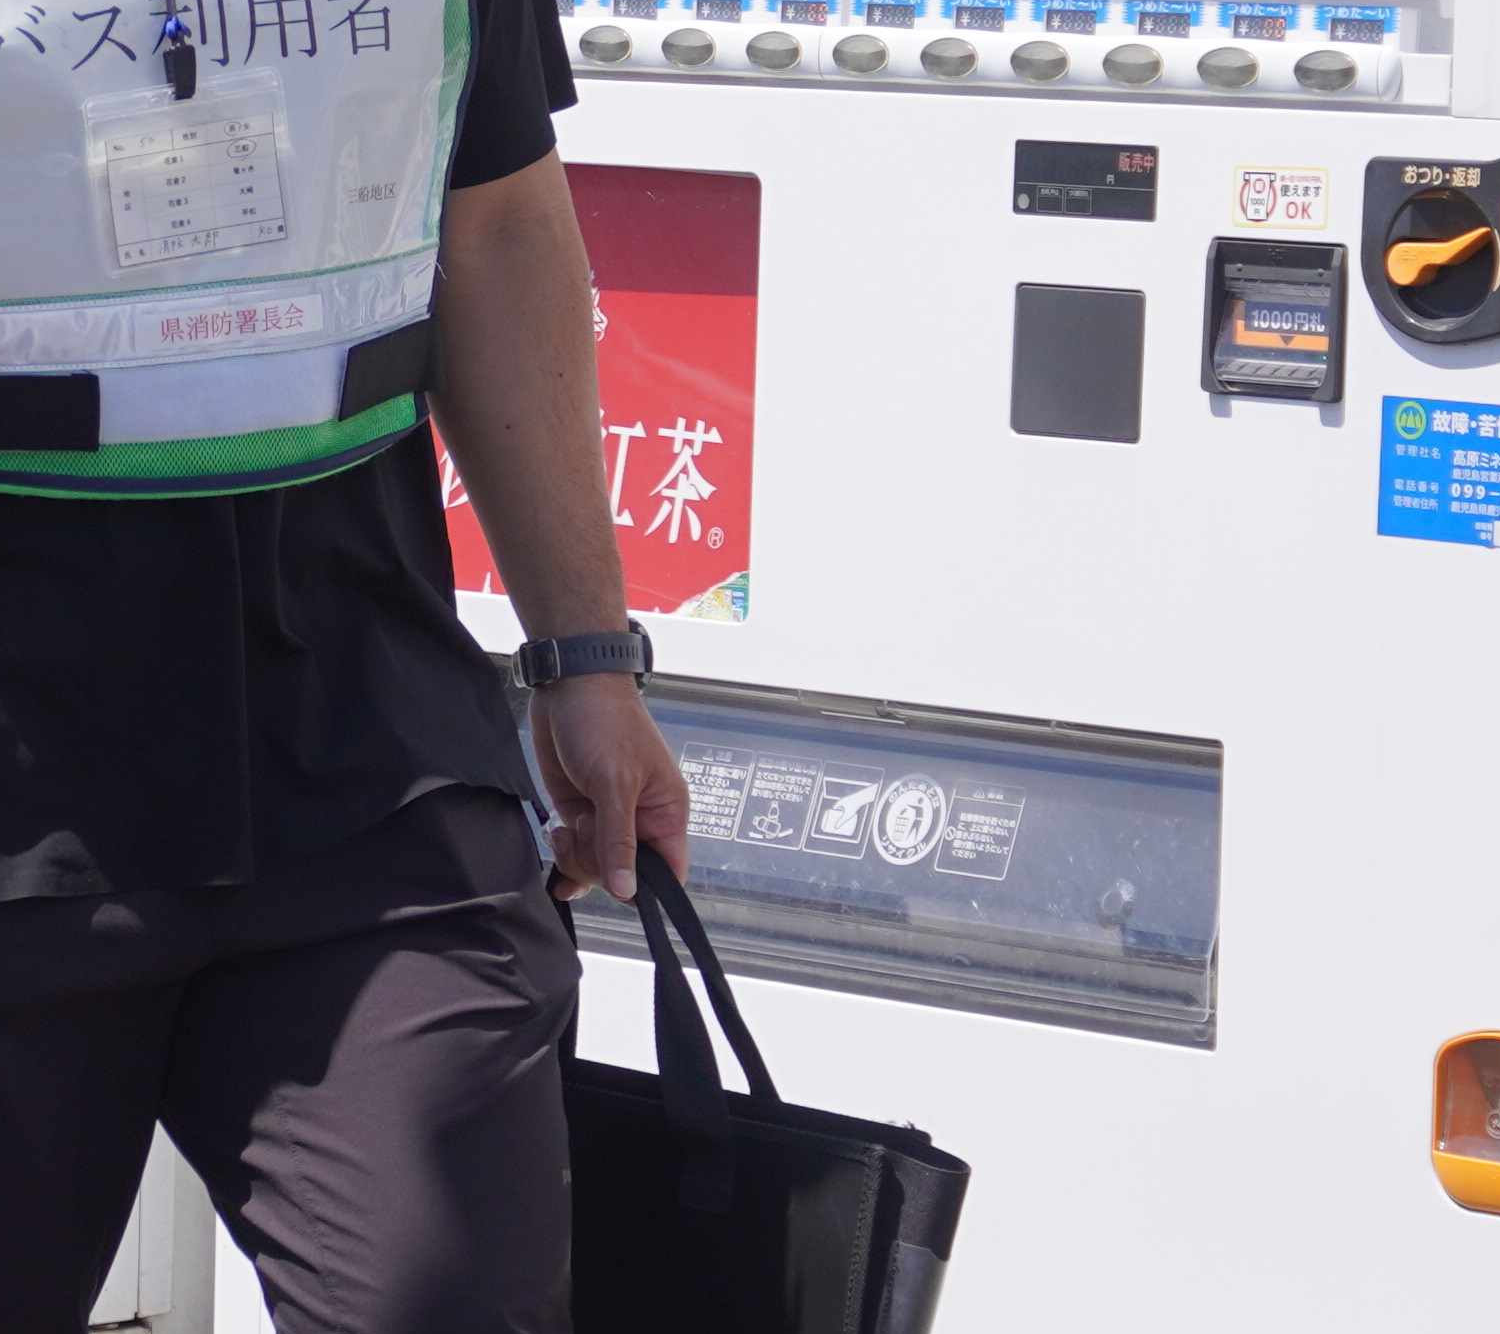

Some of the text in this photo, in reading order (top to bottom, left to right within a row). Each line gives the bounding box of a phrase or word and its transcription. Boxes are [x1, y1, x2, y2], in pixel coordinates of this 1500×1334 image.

[1118, 152, 1156, 173] 販売中
[1404, 165, 1481, 188] おつり・返却
[347, 182, 397, 205] 三船地区
[1281, 186, 1322, 198] 使えます
[1251, 198, 1266, 207] 1000
[1285, 201, 1312, 220] OK
[160, 303, 305, 344] 県消防署長会
[1250, 308, 1326, 334] 1000円札
[1395, 444, 1441, 459] 管理社名
[1394, 479, 1440, 493] 電話番号
